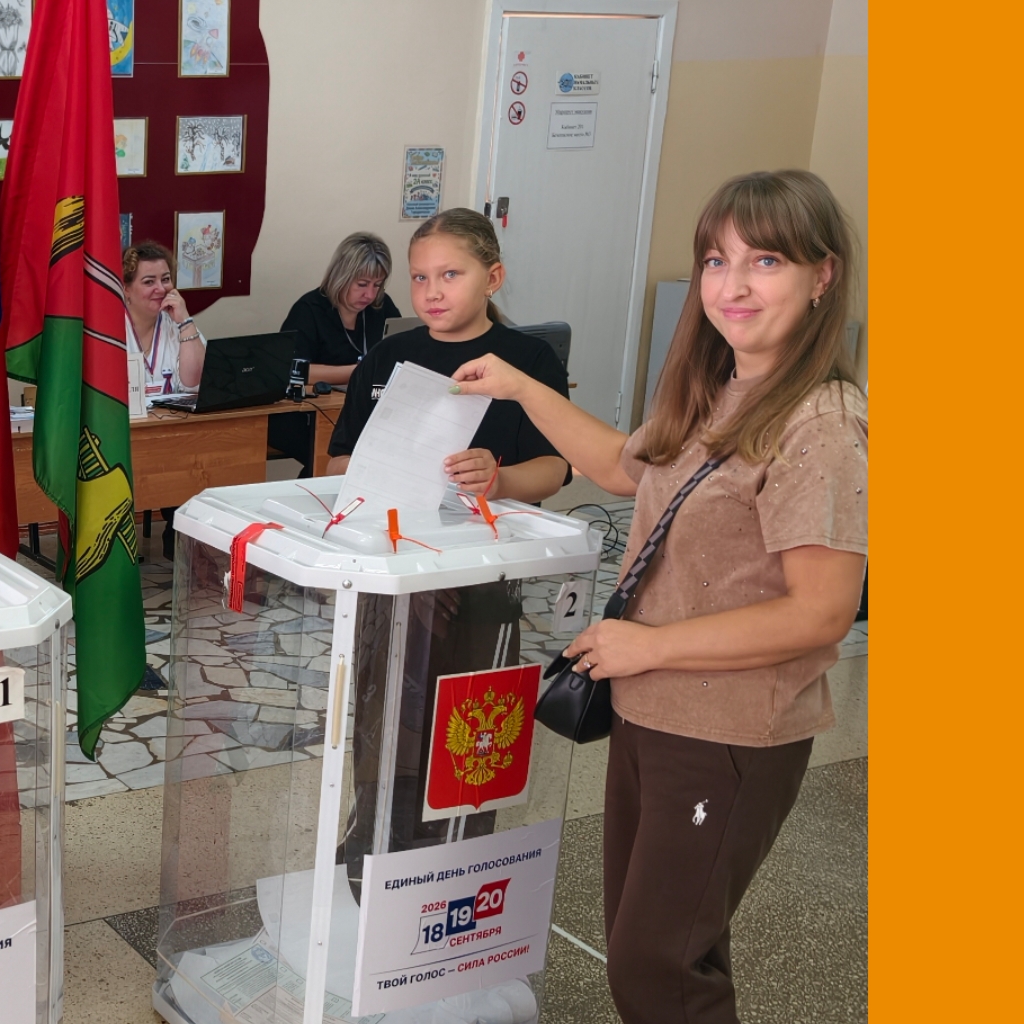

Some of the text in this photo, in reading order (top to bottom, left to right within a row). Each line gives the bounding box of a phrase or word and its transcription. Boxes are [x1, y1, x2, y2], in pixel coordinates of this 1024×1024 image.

[563, 591, 578, 618] 2
[384, 848, 542, 891] ЕДИНЫЙ ДЕНЬ ГОЛОСОВАНИЯ
[421, 900, 447, 914] 2026
[475, 888, 503, 912] 20
[449, 905, 472, 928] 19
[422, 922, 444, 945] 18
[449, 926, 502, 948] СЕНТЯБРЯ
[377, 975, 407, 990] ТВОЙ
[410, 968, 446, 984] ГОЛОС
[457, 958, 485, 973] СИЛА
[487, 944, 530, 965] РОССИИ!
